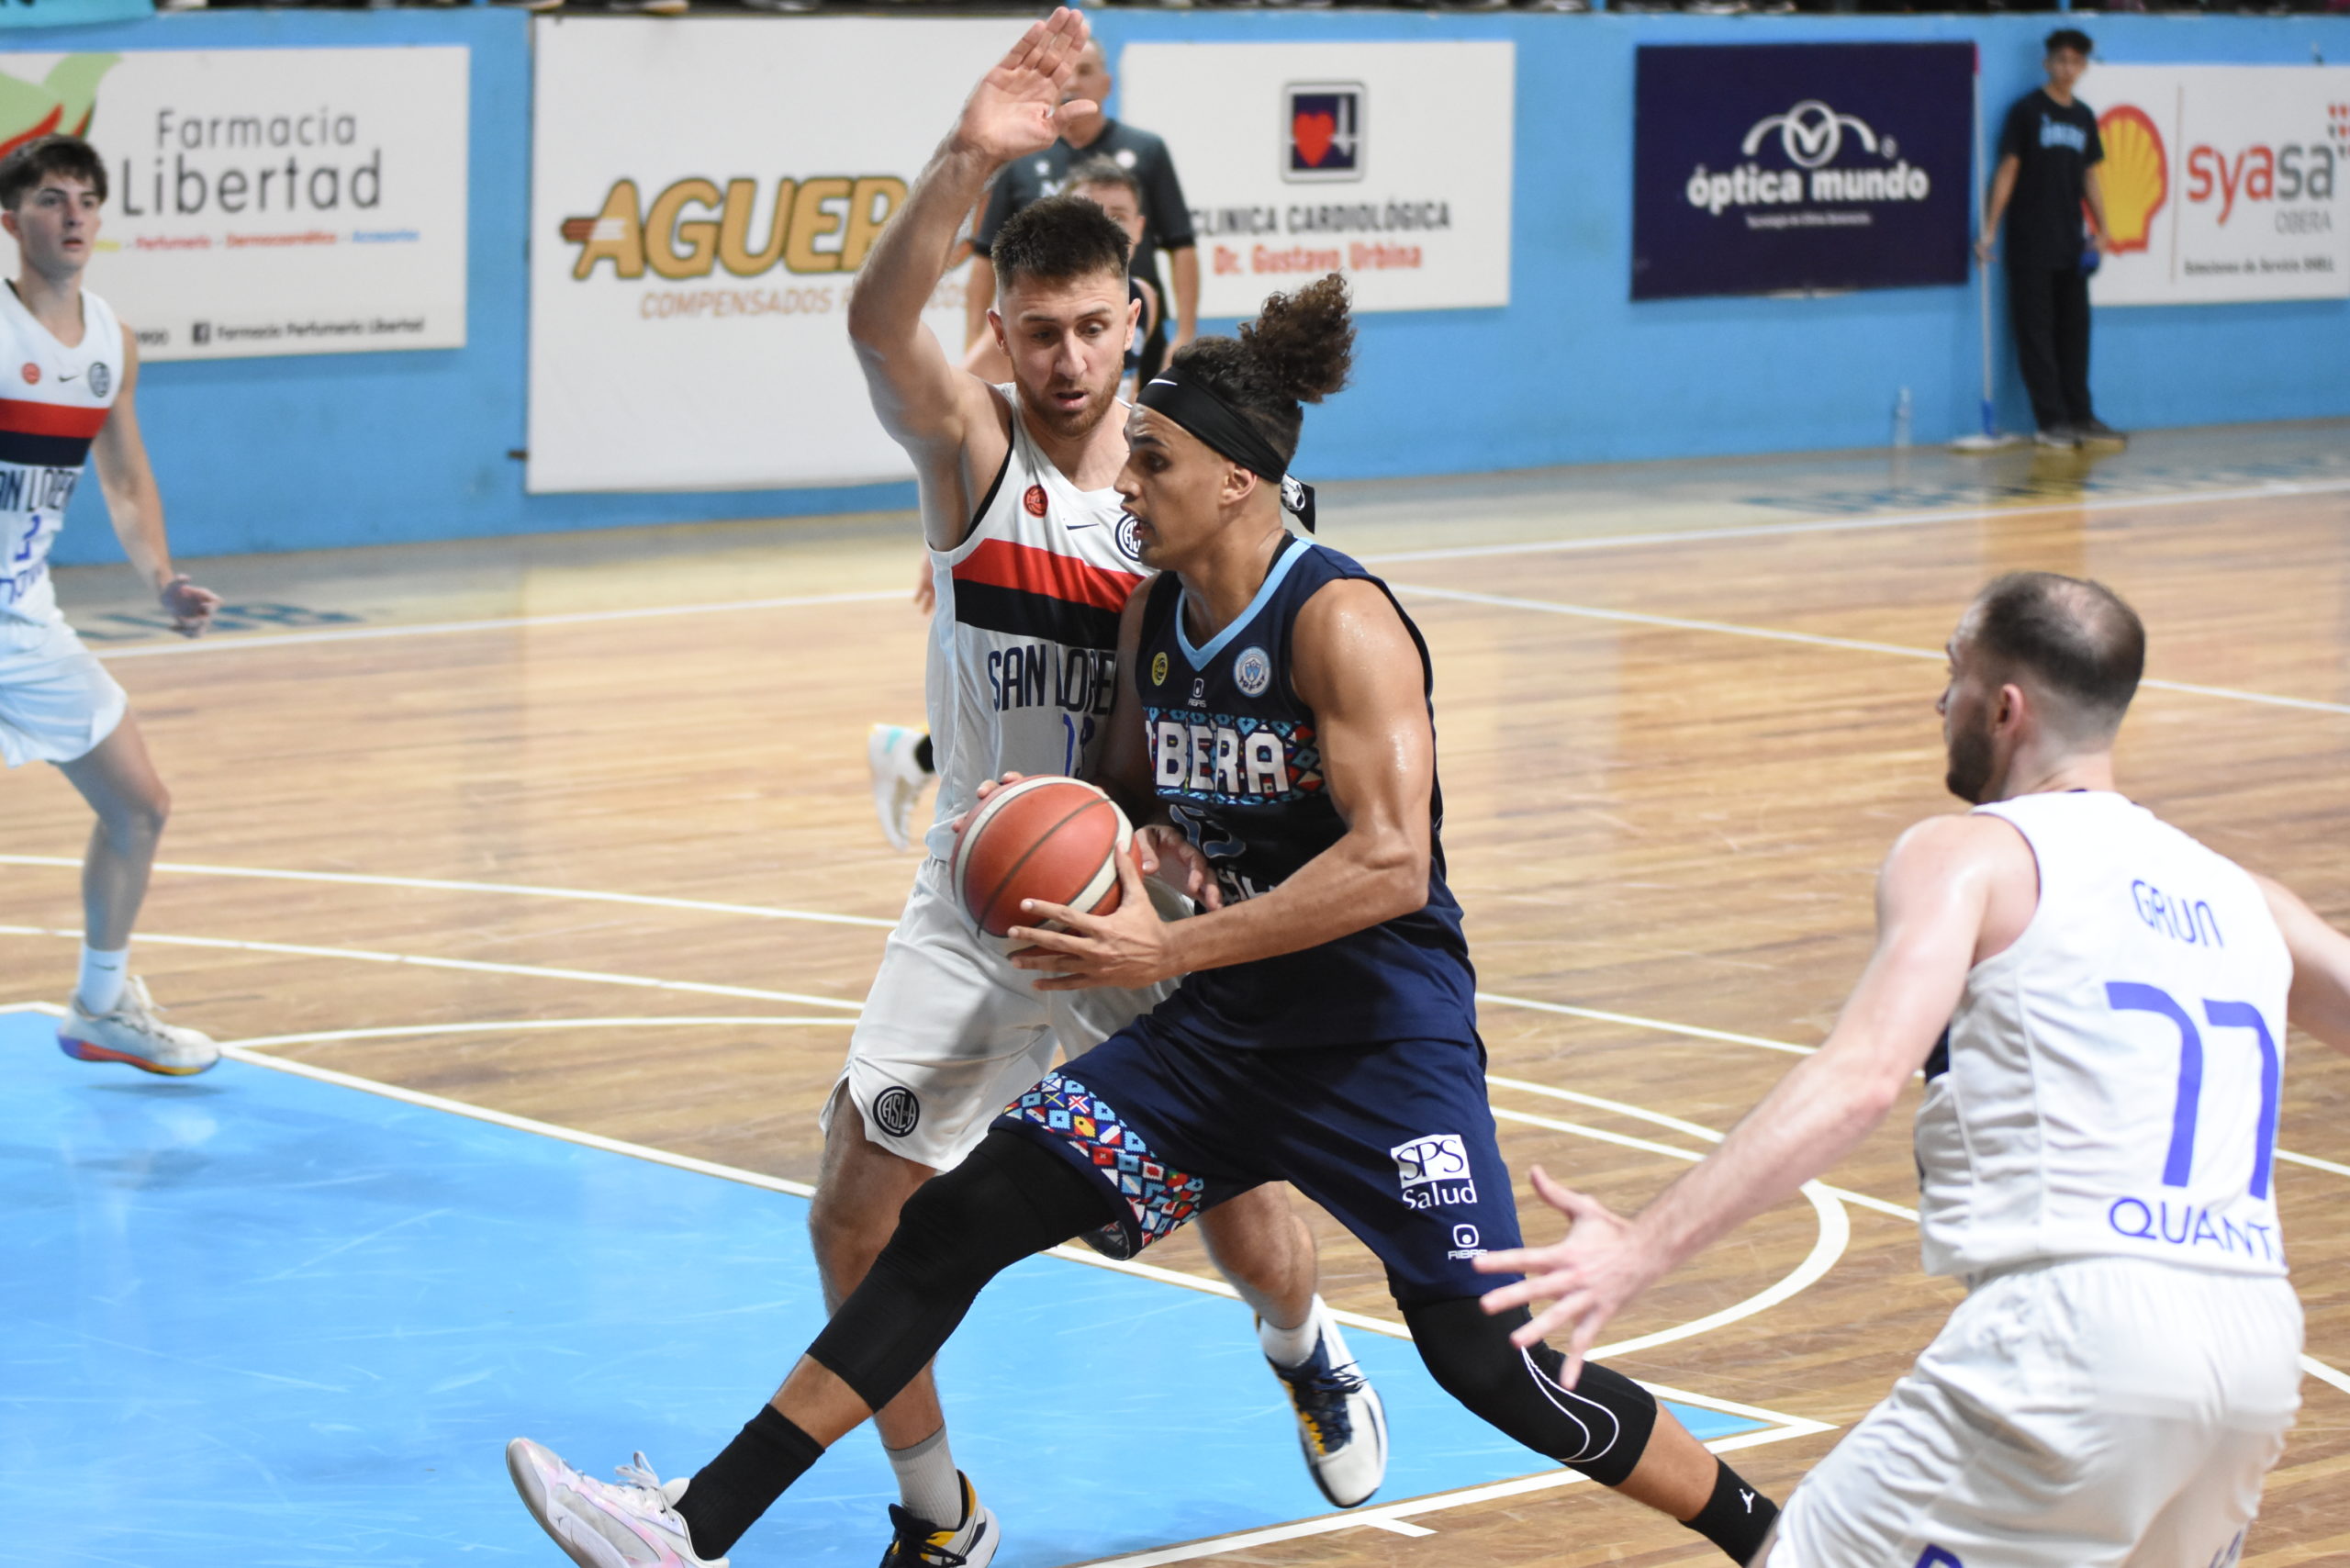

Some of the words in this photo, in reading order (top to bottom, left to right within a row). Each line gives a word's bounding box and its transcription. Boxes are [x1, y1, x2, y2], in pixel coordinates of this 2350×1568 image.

[156, 106, 358, 150] Farmacia
[122, 149, 382, 217] Libertad
[1687, 163, 1802, 216] óptica
[1811, 160, 1930, 201] mundo
[2187, 143, 2334, 227] syasa
[1287, 195, 1450, 233] CARDIOLÓGICA
[1213, 244, 1243, 275] Dr.
[1251, 243, 1340, 274] Gustavo
[1349, 241, 1422, 270] Urbina
[639, 286, 834, 319] COMPENSADOS
[988, 644, 1046, 713] SAN
[1145, 719, 1290, 795] BERA
[2132, 879, 2224, 949] GRUN
[2105, 980, 2280, 1202] 77
[1396, 1138, 1464, 1181] SPS
[1402, 1178, 1478, 1211] Salud
